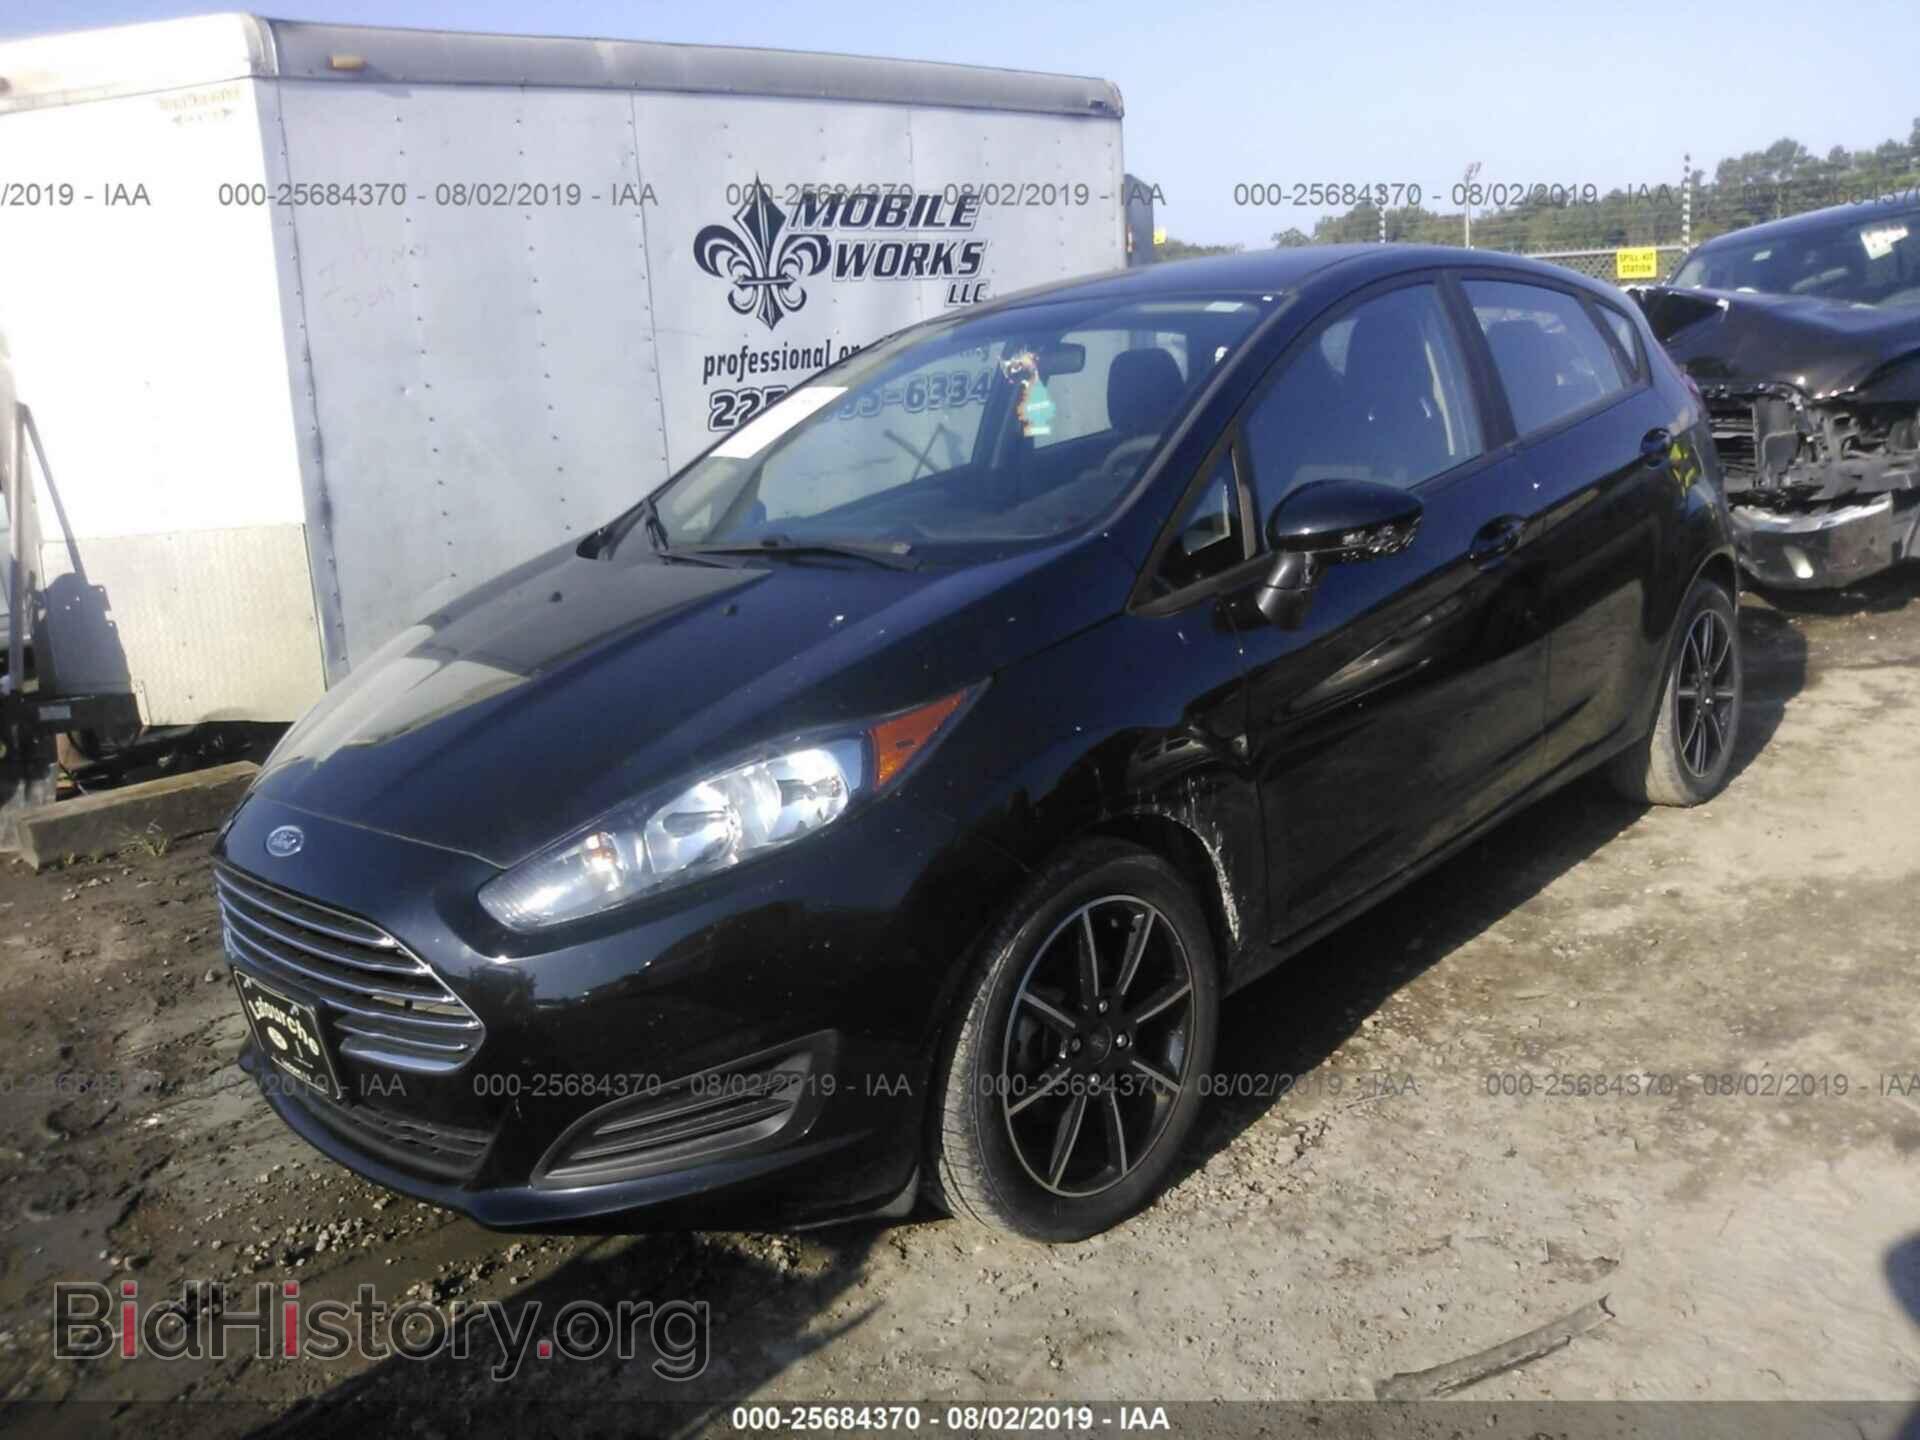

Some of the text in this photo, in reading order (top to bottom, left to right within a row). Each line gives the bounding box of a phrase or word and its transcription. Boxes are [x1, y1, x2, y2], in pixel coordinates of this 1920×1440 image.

[789, 192, 980, 229] MOBILE
[833, 240, 985, 279] WORKS
[947, 280, 988, 304] LLC
[702, 339, 831, 385] professional
